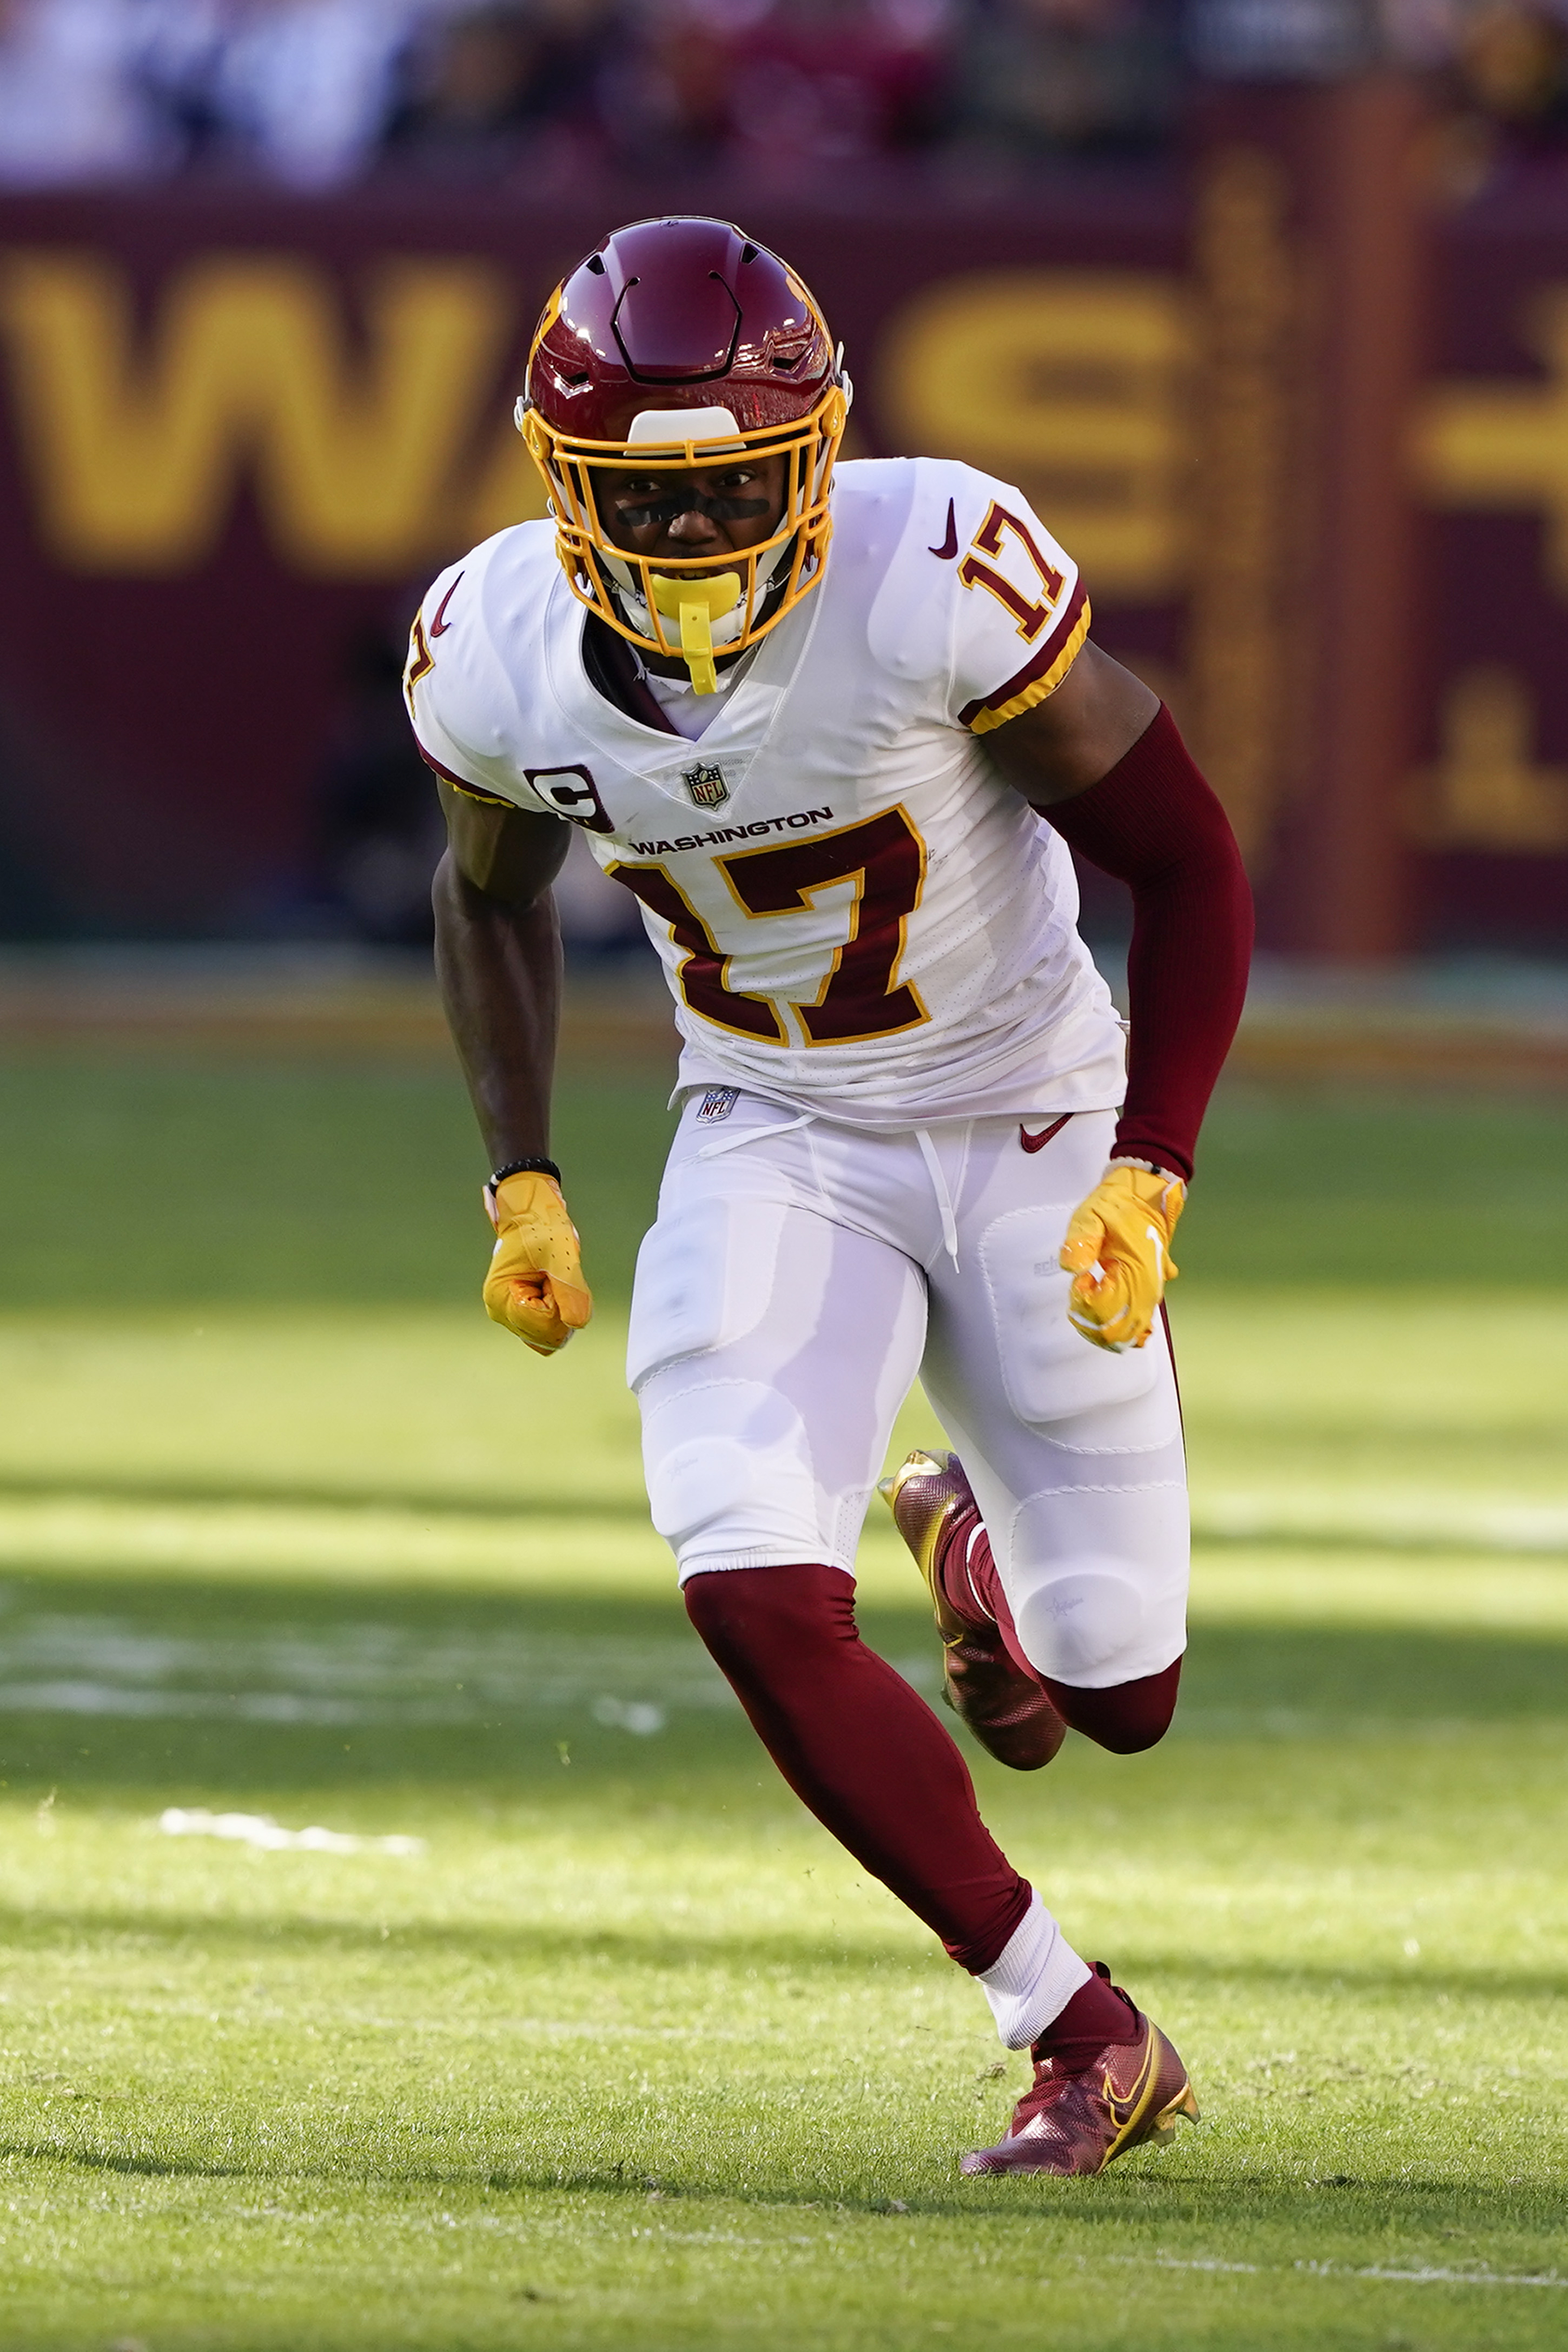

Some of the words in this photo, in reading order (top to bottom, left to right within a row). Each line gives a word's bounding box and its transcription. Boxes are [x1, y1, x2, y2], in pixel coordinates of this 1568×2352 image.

[957, 499, 1066, 645] 17
[533, 772, 597, 817] C
[694, 782, 723, 802] NFL
[628, 807, 834, 855] WASHINGTON
[604, 802, 932, 1048] 17
[702, 1101, 726, 1116] NFL
